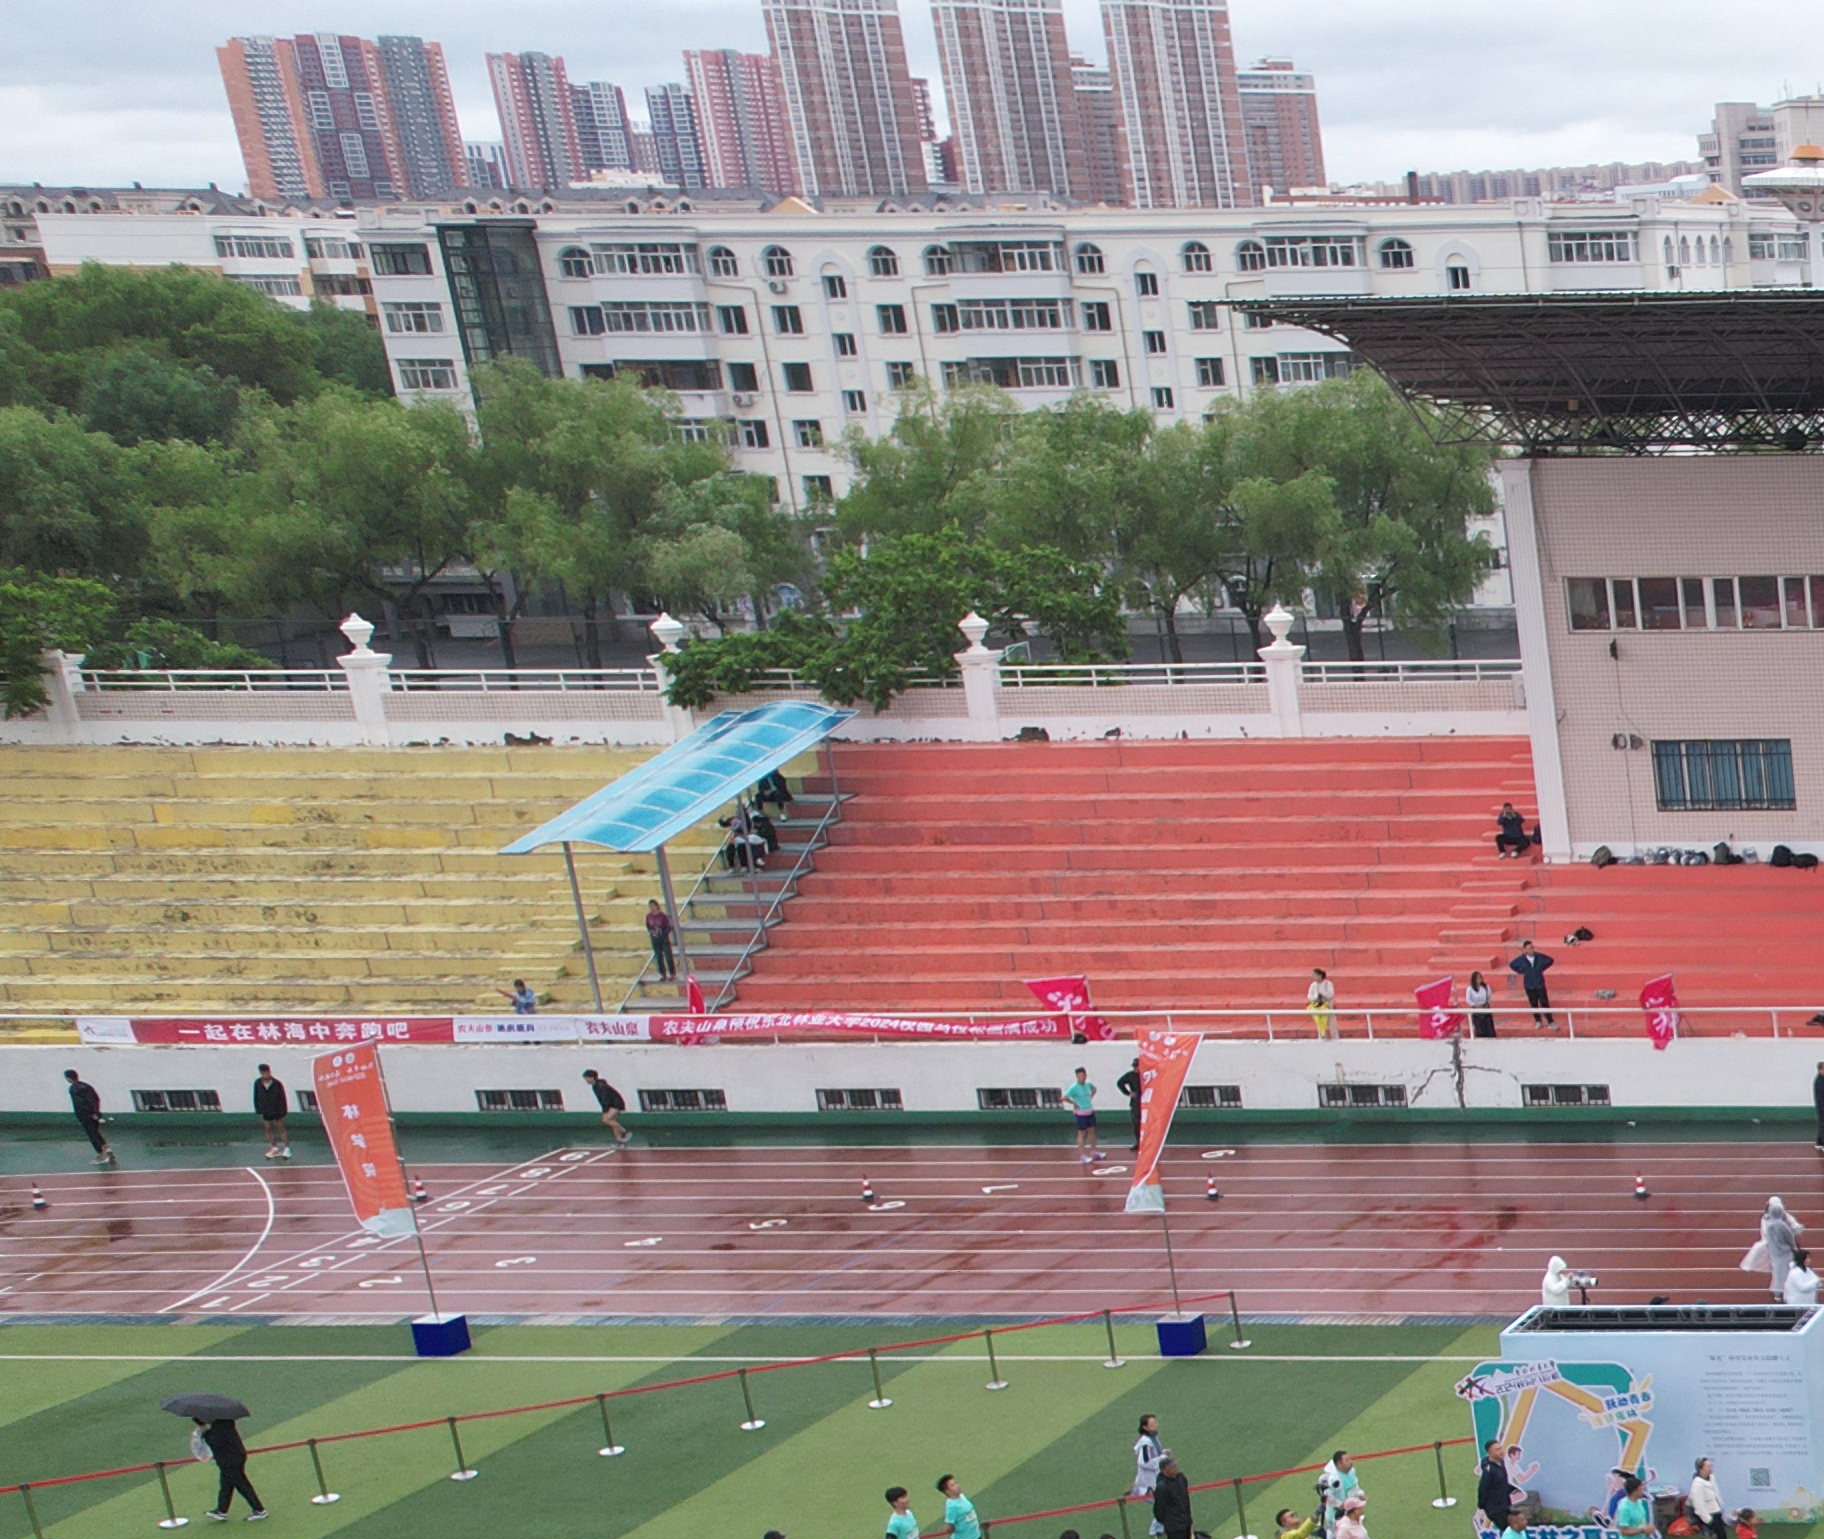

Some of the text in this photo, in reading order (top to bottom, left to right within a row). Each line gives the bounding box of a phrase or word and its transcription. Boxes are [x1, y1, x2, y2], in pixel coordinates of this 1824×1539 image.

[178, 1023, 410, 1042] 一起在林海中奔跑吧
[585, 1021, 638, 1036] 农夫山泉
